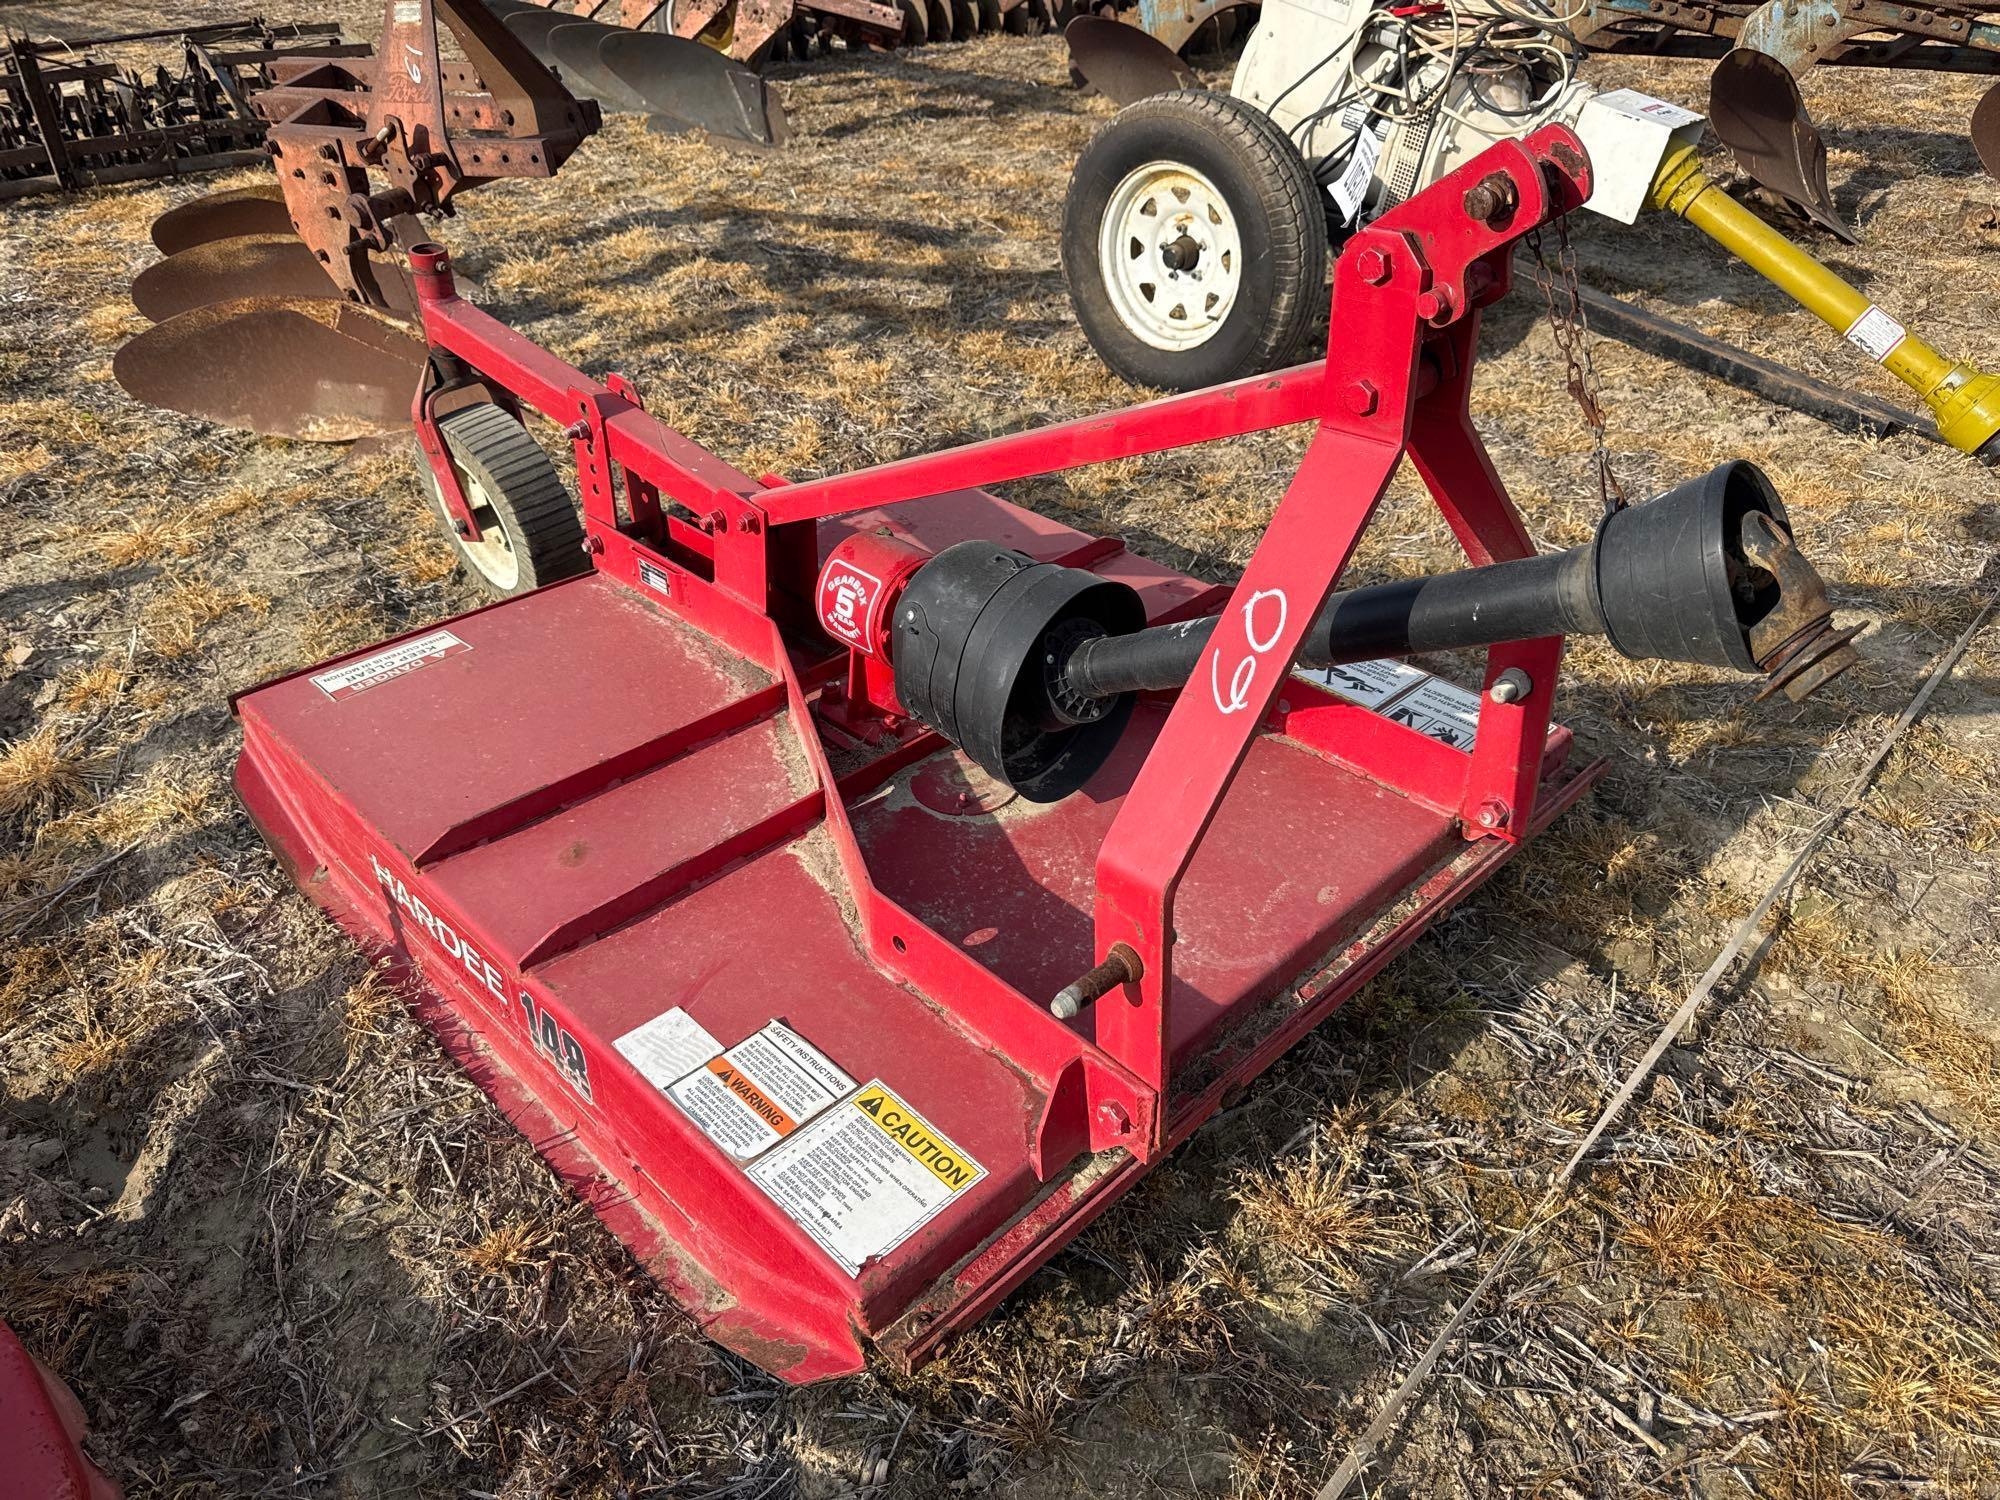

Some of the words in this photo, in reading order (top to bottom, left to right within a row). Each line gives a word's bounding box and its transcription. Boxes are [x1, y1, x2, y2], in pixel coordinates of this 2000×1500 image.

[828, 574, 867, 606] GEARBOX
[835, 586, 857, 618] 5
[832, 610, 856, 628] YEAR
[382, 645, 420, 660] CUTTER
[396, 645, 437, 662] KEEP
[419, 635, 447, 646] WHEN
[1210, 588, 1288, 714] 60
[344, 660, 396, 682] CLEAR
[350, 662, 425, 690] DANGER
[1411, 700, 1443, 713] BLADES
[1420, 692, 1438, 700] CAN
[1421, 687, 1455, 702] OBJECTS
[1436, 698, 1462, 710] DEATH
[369, 854, 508, 1005] HARDEE
[519, 989, 593, 1106] 148
[769, 1026, 798, 1049] SAFETY
[794, 1047, 847, 1091] INSTRUCTIONS
[728, 1077, 785, 1127] WARNING
[824, 1139, 835, 1148] AND
[833, 1146, 852, 1163] GUARDS
[854, 1127, 865, 1136] NOT
[862, 1135, 880, 1149] ALLOW
[877, 1148, 896, 1163] RIDERS
[857, 1115, 870, 1126] READ
[868, 1125, 896, 1148] OPERATOR'S
[894, 1147, 914, 1164] MANUAL
[877, 1109, 970, 1186] CAUTION
[809, 1149, 822, 1161] TURN
[820, 1160, 830, 1168] OFF
[829, 1167, 850, 1186] TRACTOR
[848, 1185, 866, 1201] ENGINE
[814, 1146, 827, 1157] STOP
[825, 1156, 842, 1170] POWER
[840, 1169, 862, 1189] TAKE-OFF
[860, 1187, 872, 1197] AND
[828, 1135, 842, 1147] KEEP
[839, 1145, 850, 1154] ALL
[847, 1152, 866, 1168] SAFETY
[863, 1166, 884, 1184] SHIELDS
[838, 1129, 848, 1137] USE
[846, 1136, 856, 1144] ALL
[854, 1143, 872, 1158] SAFETY
[870, 1157, 890, 1174] GUARDS
[888, 1173, 903, 1186] WHEN
[900, 1184, 927, 1207] OPERATING
[790, 1163, 799, 1171] DO
[796, 1170, 807, 1179] NOT
[805, 1178, 826, 1196] OPERATE
[799, 1157, 812, 1168] KEEP
[810, 1167, 822, 1177] FEET
[821, 1176, 832, 1186] AND
[830, 1184, 847, 1199] HANDS
[770, 1178, 784, 1190] THINK
[800, 1206, 815, 1219] WORK
[779, 1171, 795, 1185] CLEAR
[793, 1183, 803, 1192] ALL
[801, 1191, 819, 1207] DEBRIS
[828, 1216, 843, 1229] AREA
